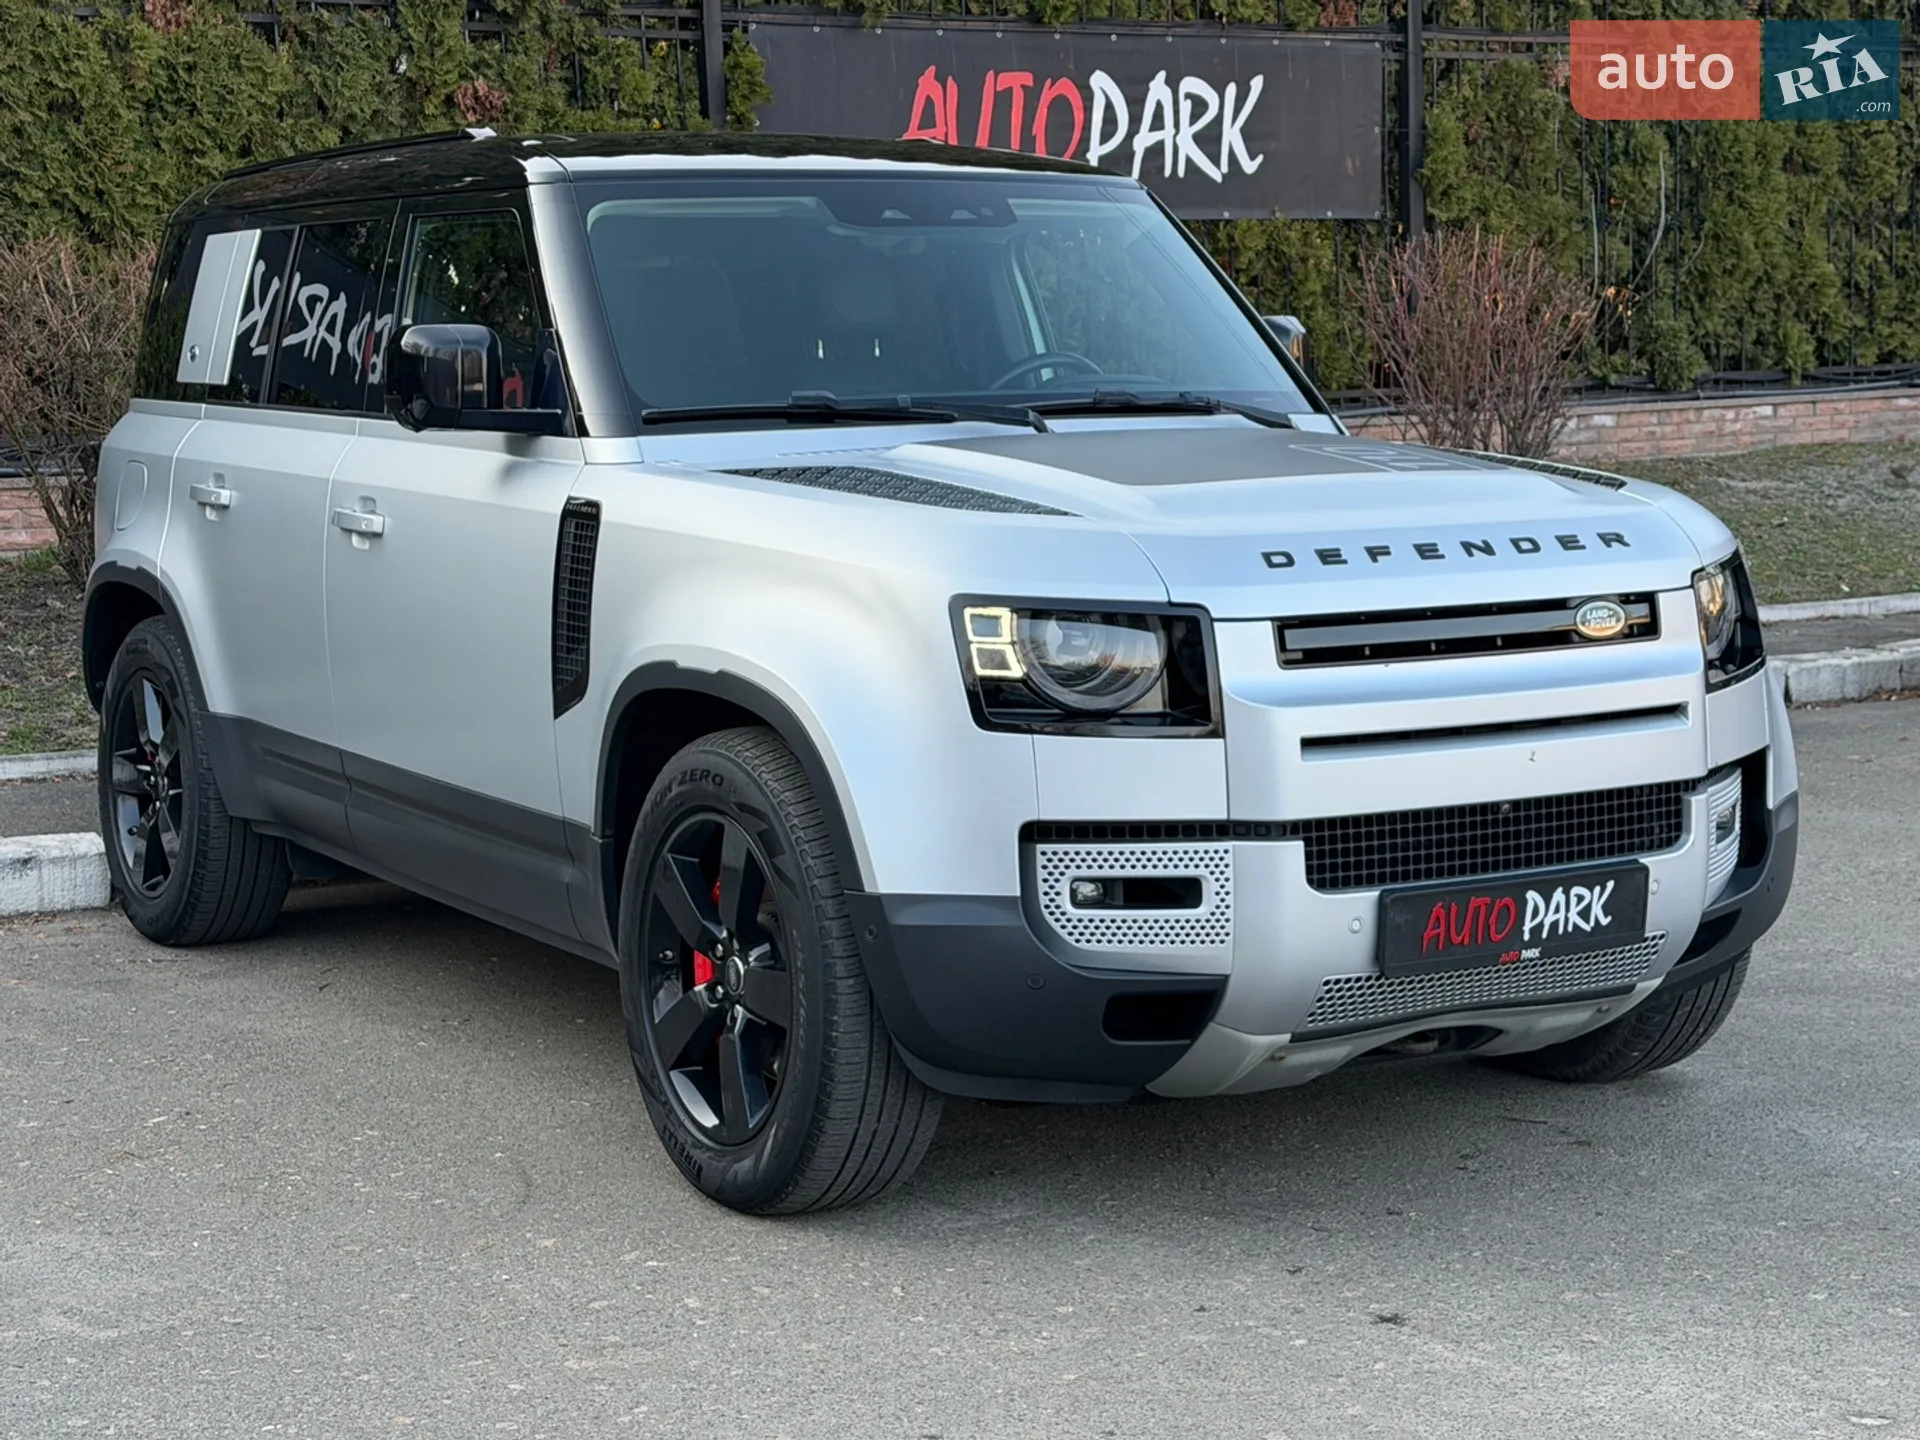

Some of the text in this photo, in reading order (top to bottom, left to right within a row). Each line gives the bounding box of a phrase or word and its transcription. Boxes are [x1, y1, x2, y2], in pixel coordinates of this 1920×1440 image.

[1261, 531, 1631, 569] DEFENDER
[1586, 608, 1608, 619] LAND
[1590, 617, 1617, 628] ROVER
[677, 767, 724, 788] ZERO
[1421, 879, 1616, 955] AUTO PARK
[1499, 946, 1542, 964] AUTO PARK
